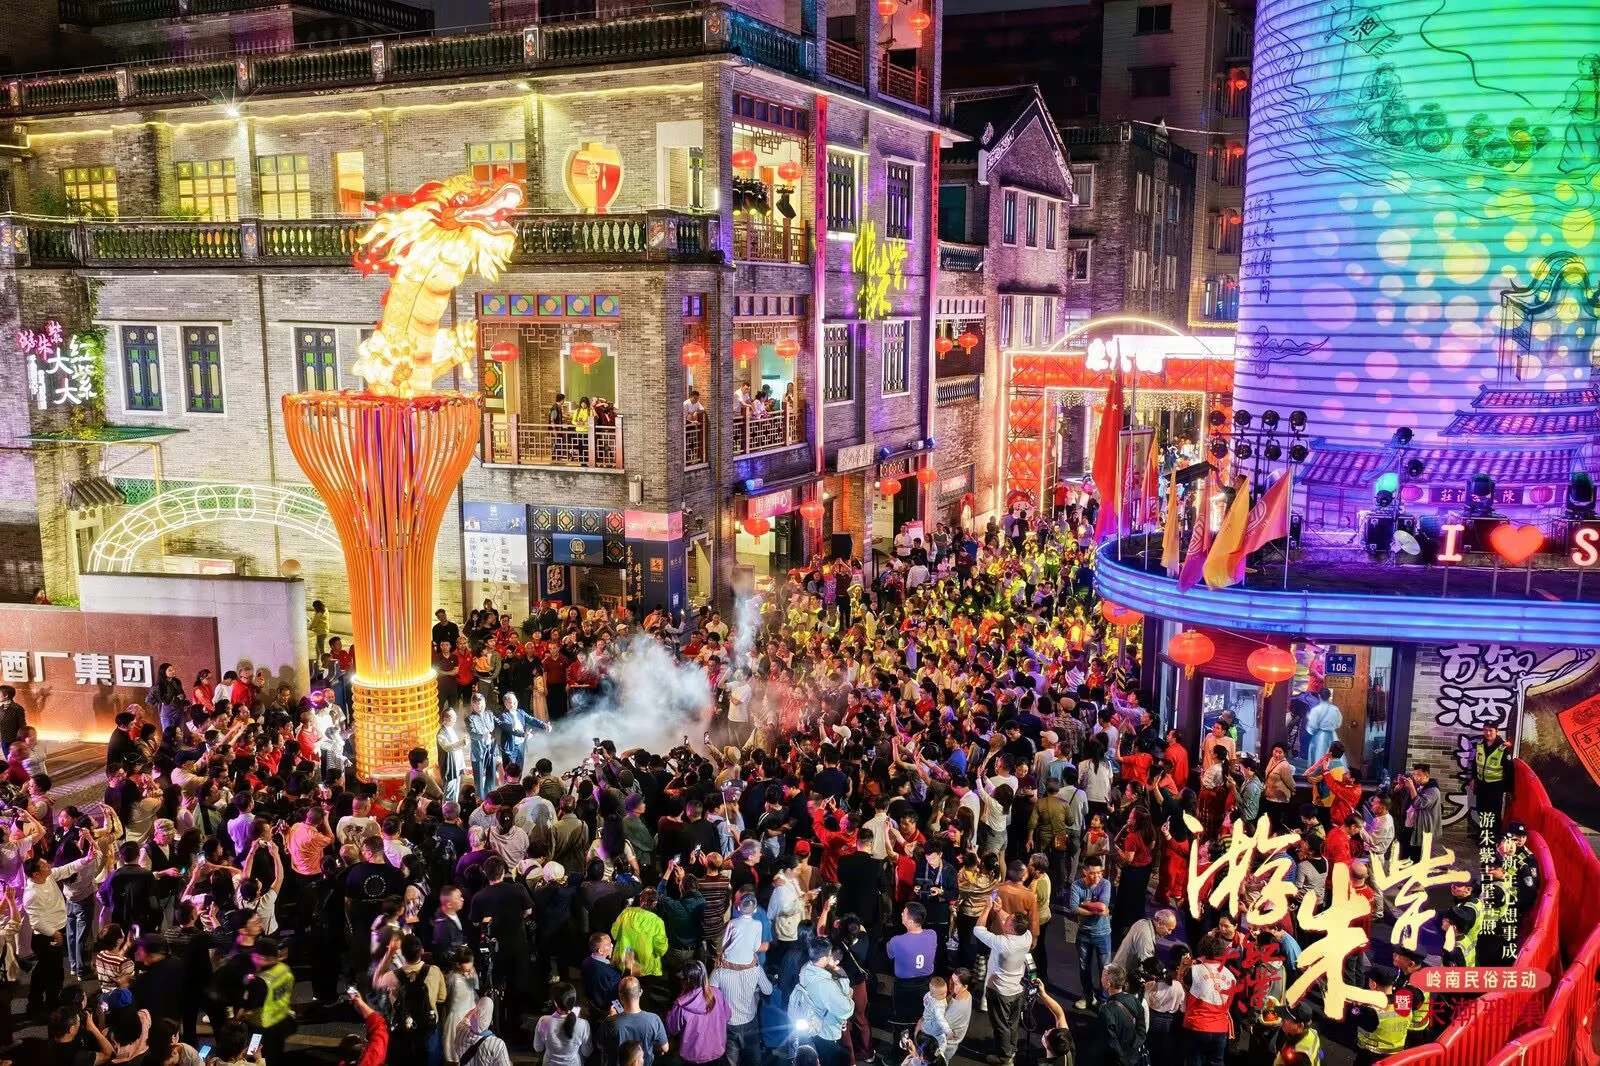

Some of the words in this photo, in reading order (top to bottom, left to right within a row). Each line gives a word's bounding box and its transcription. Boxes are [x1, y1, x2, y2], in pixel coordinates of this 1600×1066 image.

[1349, 14, 1378, 41] 酒
[1437, 524, 1465, 562] I
[1571, 527, 1600, 566] S
[1331, 663, 1347, 672] 106
[1436, 684, 1514, 730] 酒
[915, 954, 925, 970] 9
